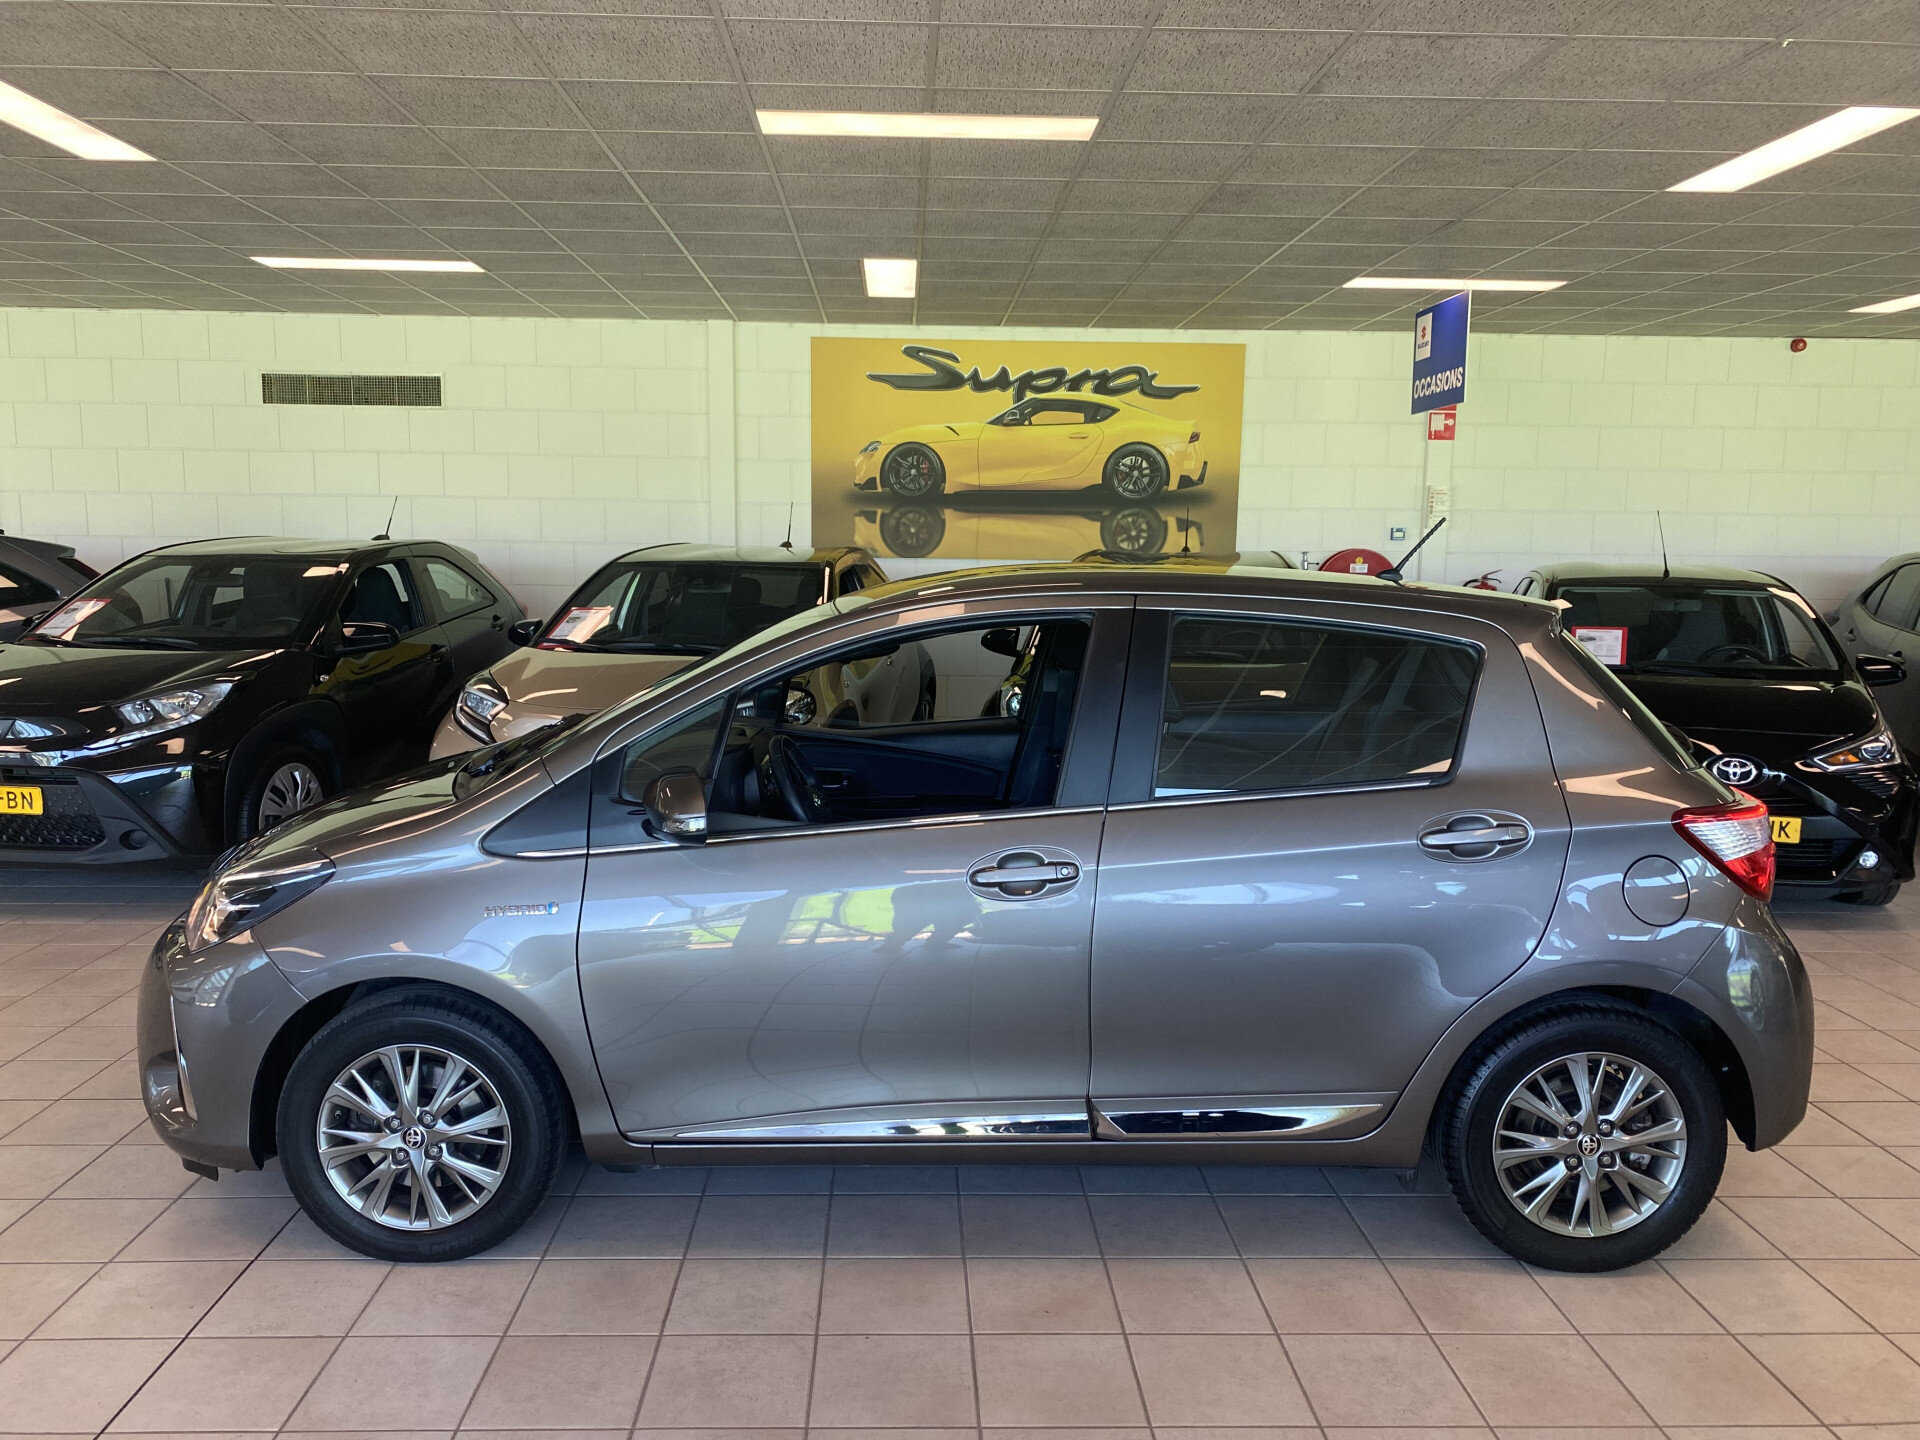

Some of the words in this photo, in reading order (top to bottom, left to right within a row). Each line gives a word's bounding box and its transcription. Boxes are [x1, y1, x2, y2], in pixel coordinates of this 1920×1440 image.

[867, 344, 1201, 404] Supra
[1413, 366, 1464, 399] OCCASIONS
[483, 904, 548, 917] HYBRID
